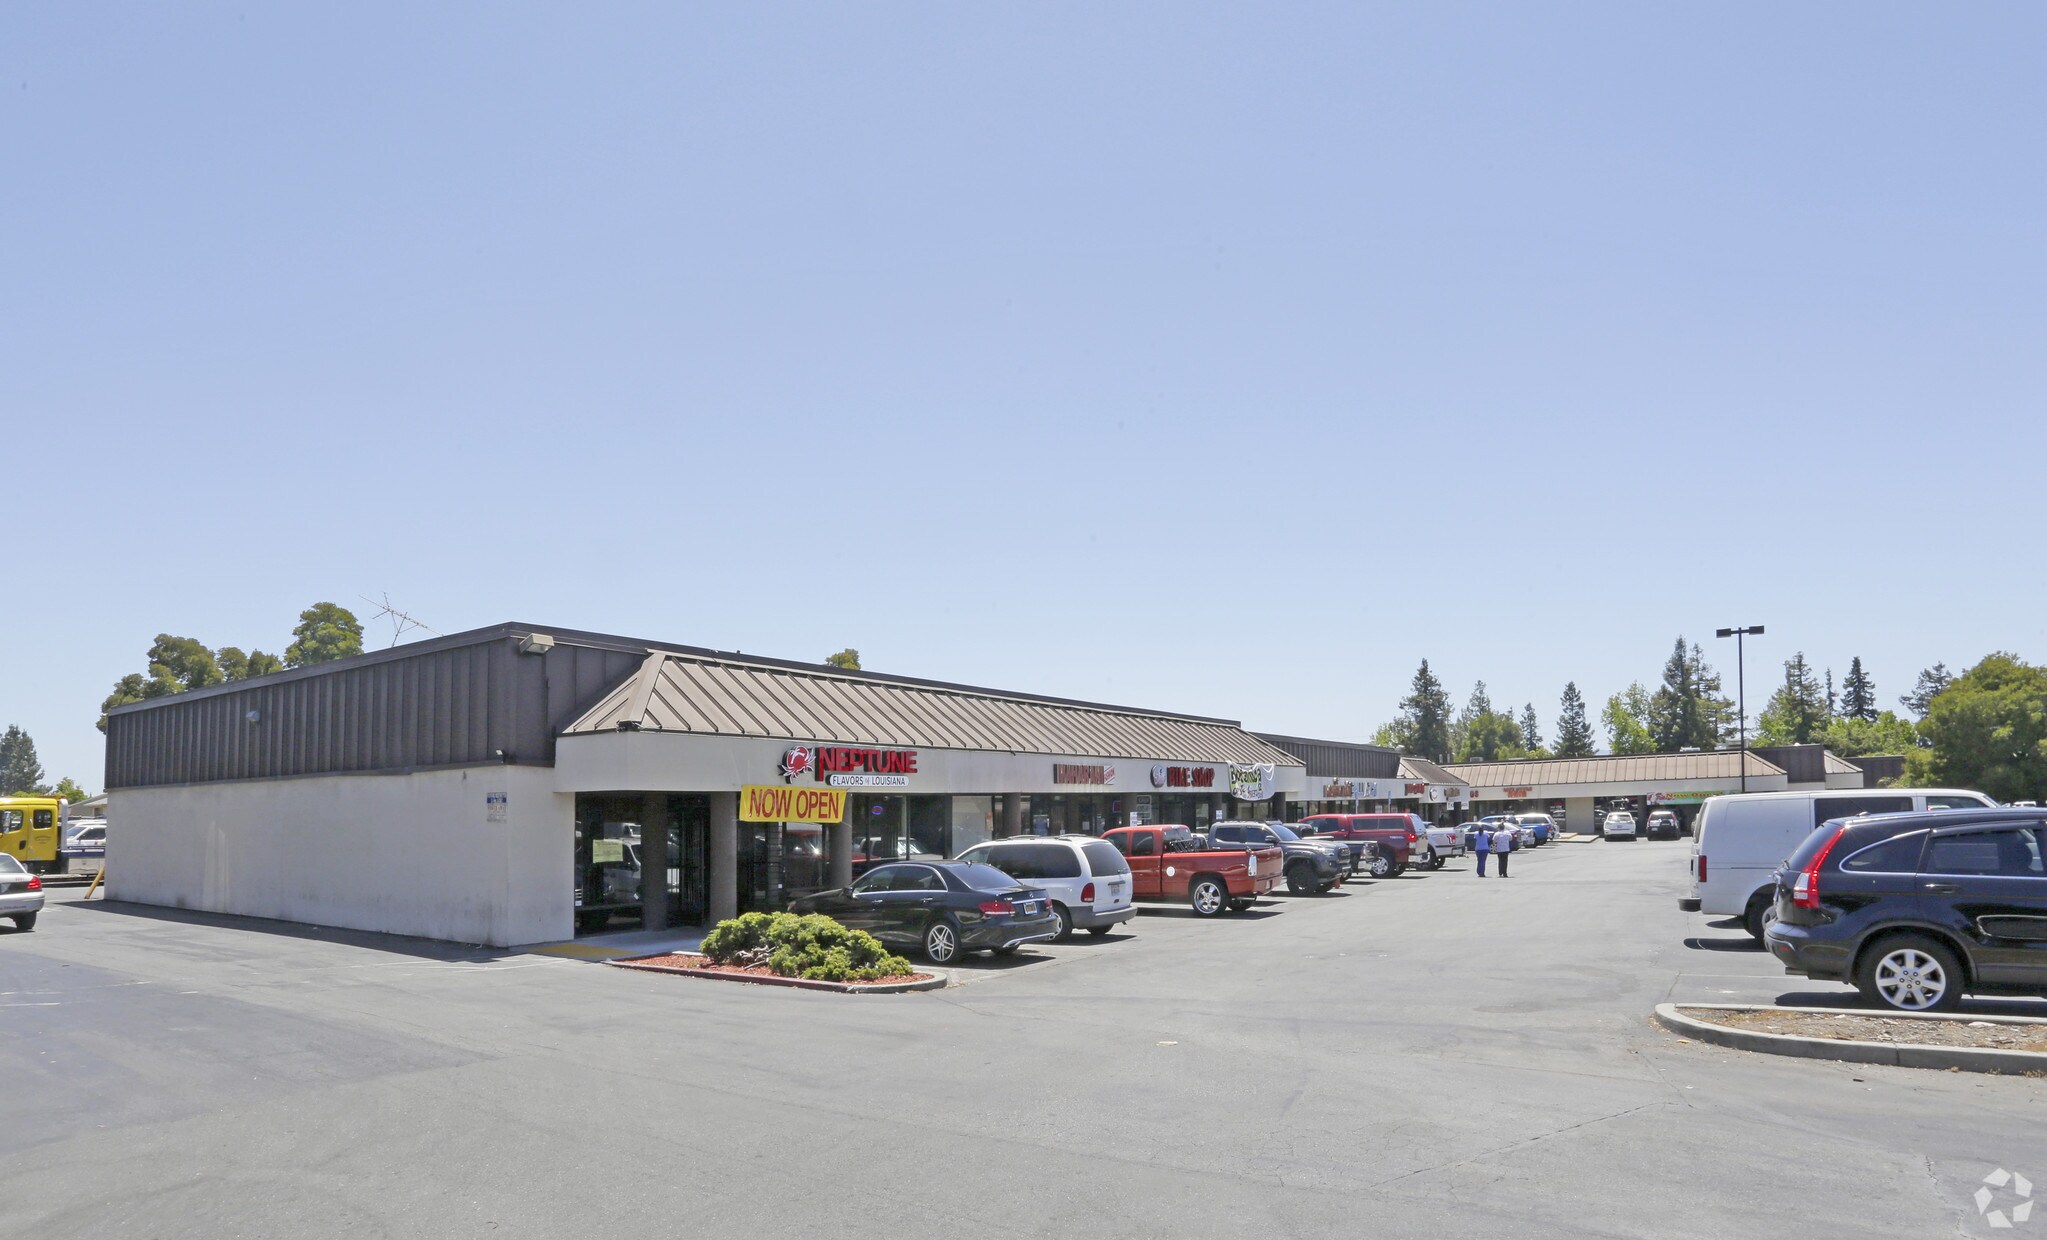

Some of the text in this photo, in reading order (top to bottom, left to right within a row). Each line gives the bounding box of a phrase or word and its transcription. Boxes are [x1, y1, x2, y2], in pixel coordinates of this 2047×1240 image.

[817, 746, 918, 782] NEPTUNE
[1167, 766, 1215, 787] BIKE SHOP
[832, 775, 864, 786] FLAVORS
[871, 776, 906, 786] LOUISIANA
[749, 788, 839, 819] NOW OPEN
